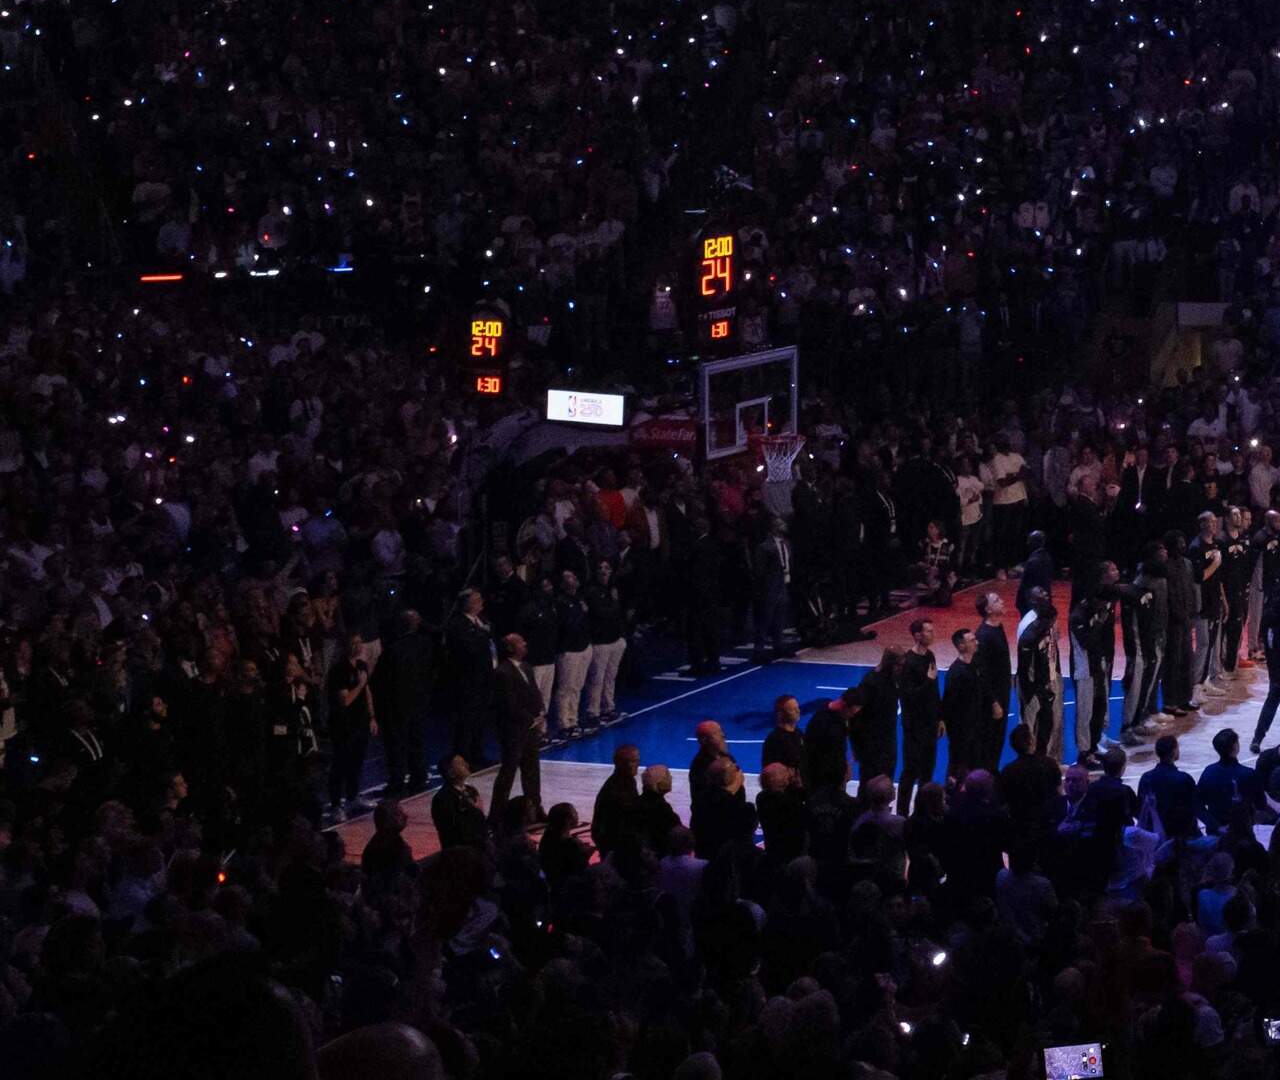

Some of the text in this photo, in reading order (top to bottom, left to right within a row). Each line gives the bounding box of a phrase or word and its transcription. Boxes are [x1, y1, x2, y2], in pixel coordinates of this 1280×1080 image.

[703, 235, 735, 259] 12:00
[700, 258, 733, 296] 24
[470, 320, 504, 338] 12:00
[471, 338, 498, 358] 24
[476, 376, 500, 394] 1:30
